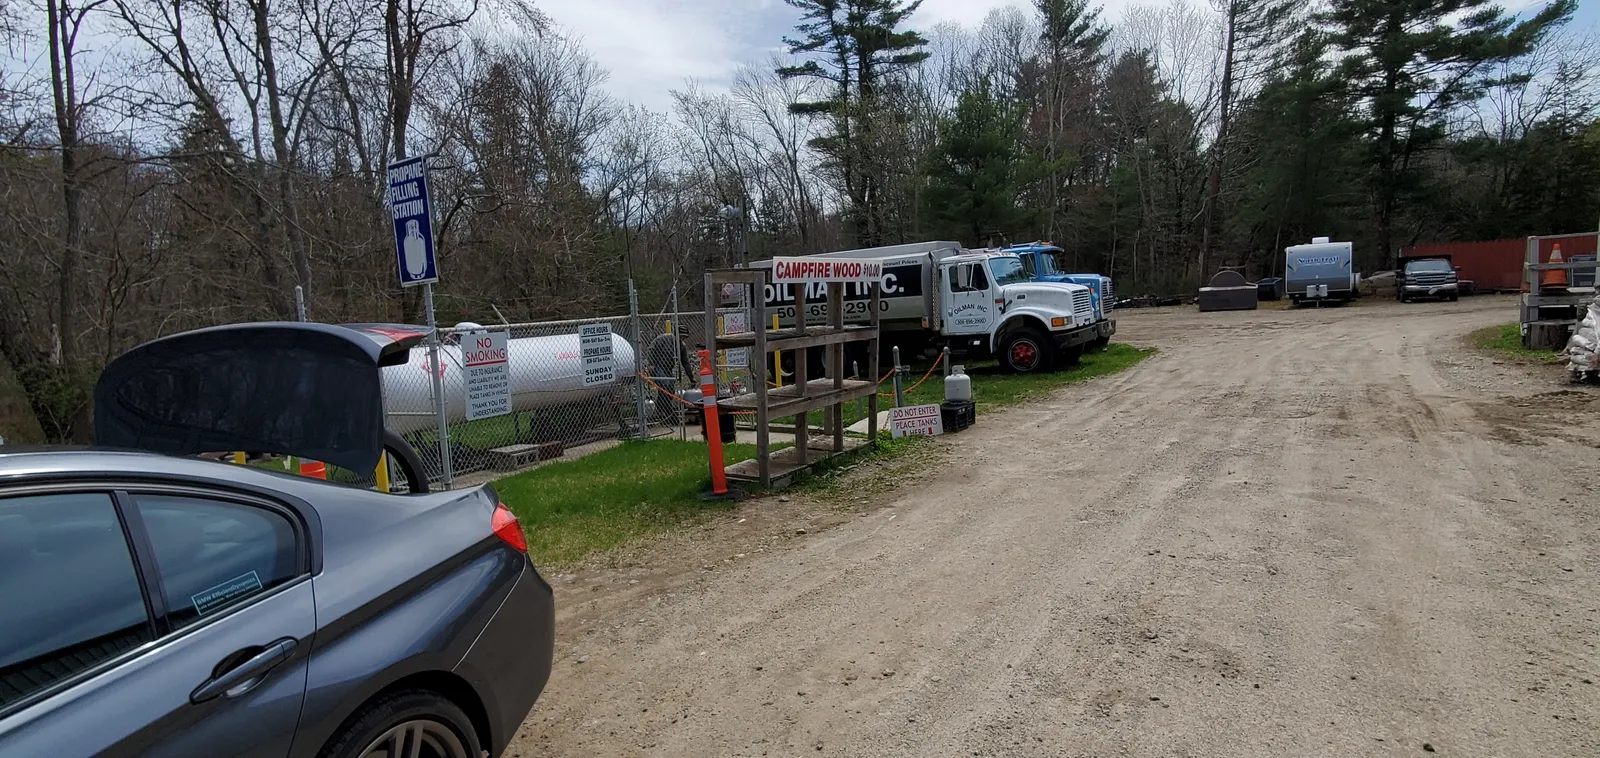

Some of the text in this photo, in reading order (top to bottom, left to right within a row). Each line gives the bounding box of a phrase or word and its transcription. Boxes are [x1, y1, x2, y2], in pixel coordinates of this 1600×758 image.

[389, 162, 423, 185] PROPANE
[391, 181, 419, 202] FILLING
[393, 199, 424, 220] STATION
[776, 261, 880, 279] CAMPFIRE WOOD $10.00
[954, 303, 987, 314] OILMAN INC
[582, 326, 609, 335] OFFICE HOURS
[476, 337, 492, 349] NO
[466, 348, 506, 363] SMOKING
[583, 347, 600, 356] PROPANE
[479, 368, 484, 376] TO
[484, 366, 503, 374] INSURANCE
[585, 366, 612, 376] SUNDAY
[477, 376, 493, 384] LIABILITY
[585, 373, 613, 383] CLOSED
[472, 401, 488, 410] THANK
[472, 405, 507, 418] UNDERSTANDING
[894, 406, 937, 418] DO NOT ENTER
[896, 418, 938, 430] PLACE TANKS
[910, 428, 926, 436] HERE
[197, 594, 212, 605] BMW
